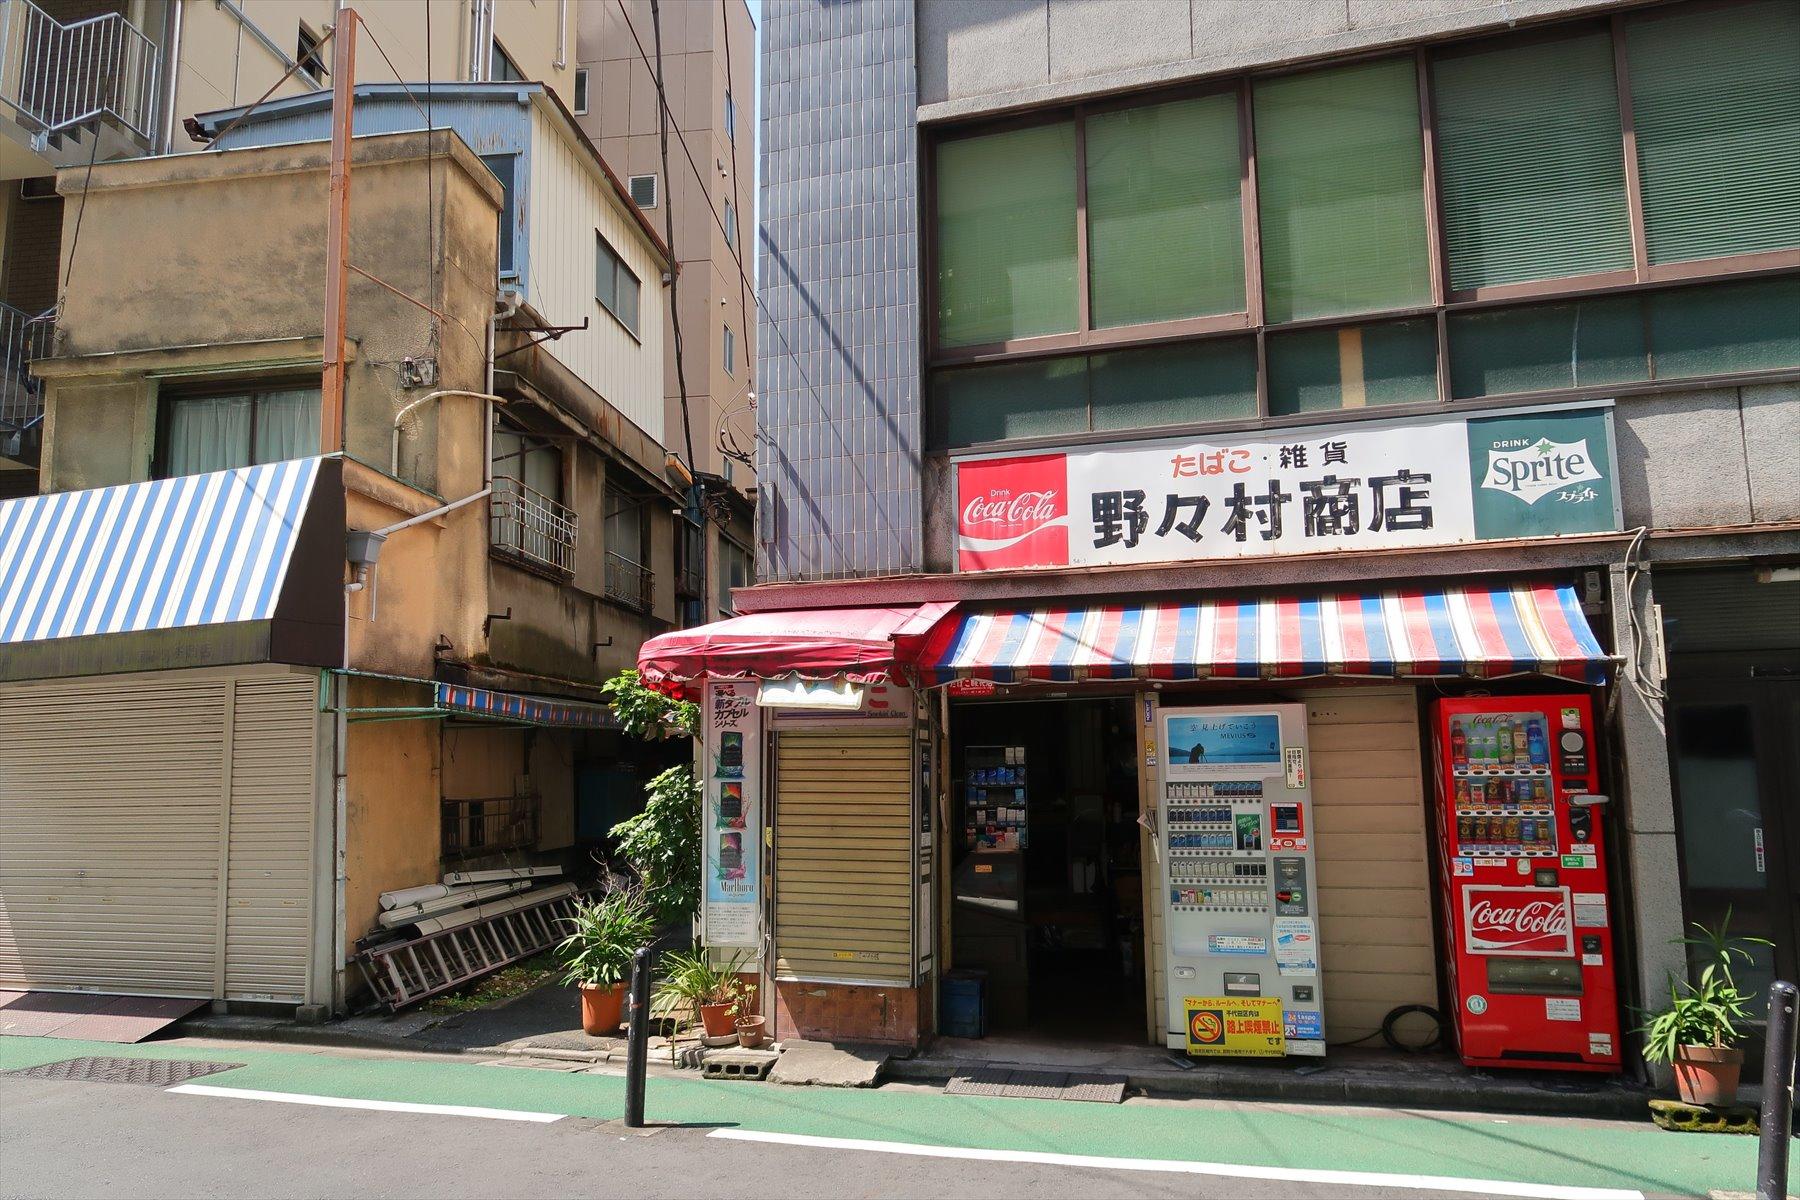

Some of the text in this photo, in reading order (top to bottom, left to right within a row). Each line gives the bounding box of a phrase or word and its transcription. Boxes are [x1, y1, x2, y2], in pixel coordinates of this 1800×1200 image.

[1493, 439, 1529, 448] DRINK
[1492, 452, 1585, 492] Sprite
[990, 488, 1011, 497] Drink
[1555, 487, 1599, 504] スプライト
[963, 488, 1059, 525] Coca-Cola
[1093, 469, 1433, 549] 野々村商店
[714, 708, 749, 720] カプセル
[714, 720, 738, 729] シリーズ
[1220, 732, 1247, 740] MEVIUS
[720, 878, 754, 893] Marlboro
[1470, 900, 1567, 934] Coca-Cola
[1267, 1037, 1281, 1045] です
